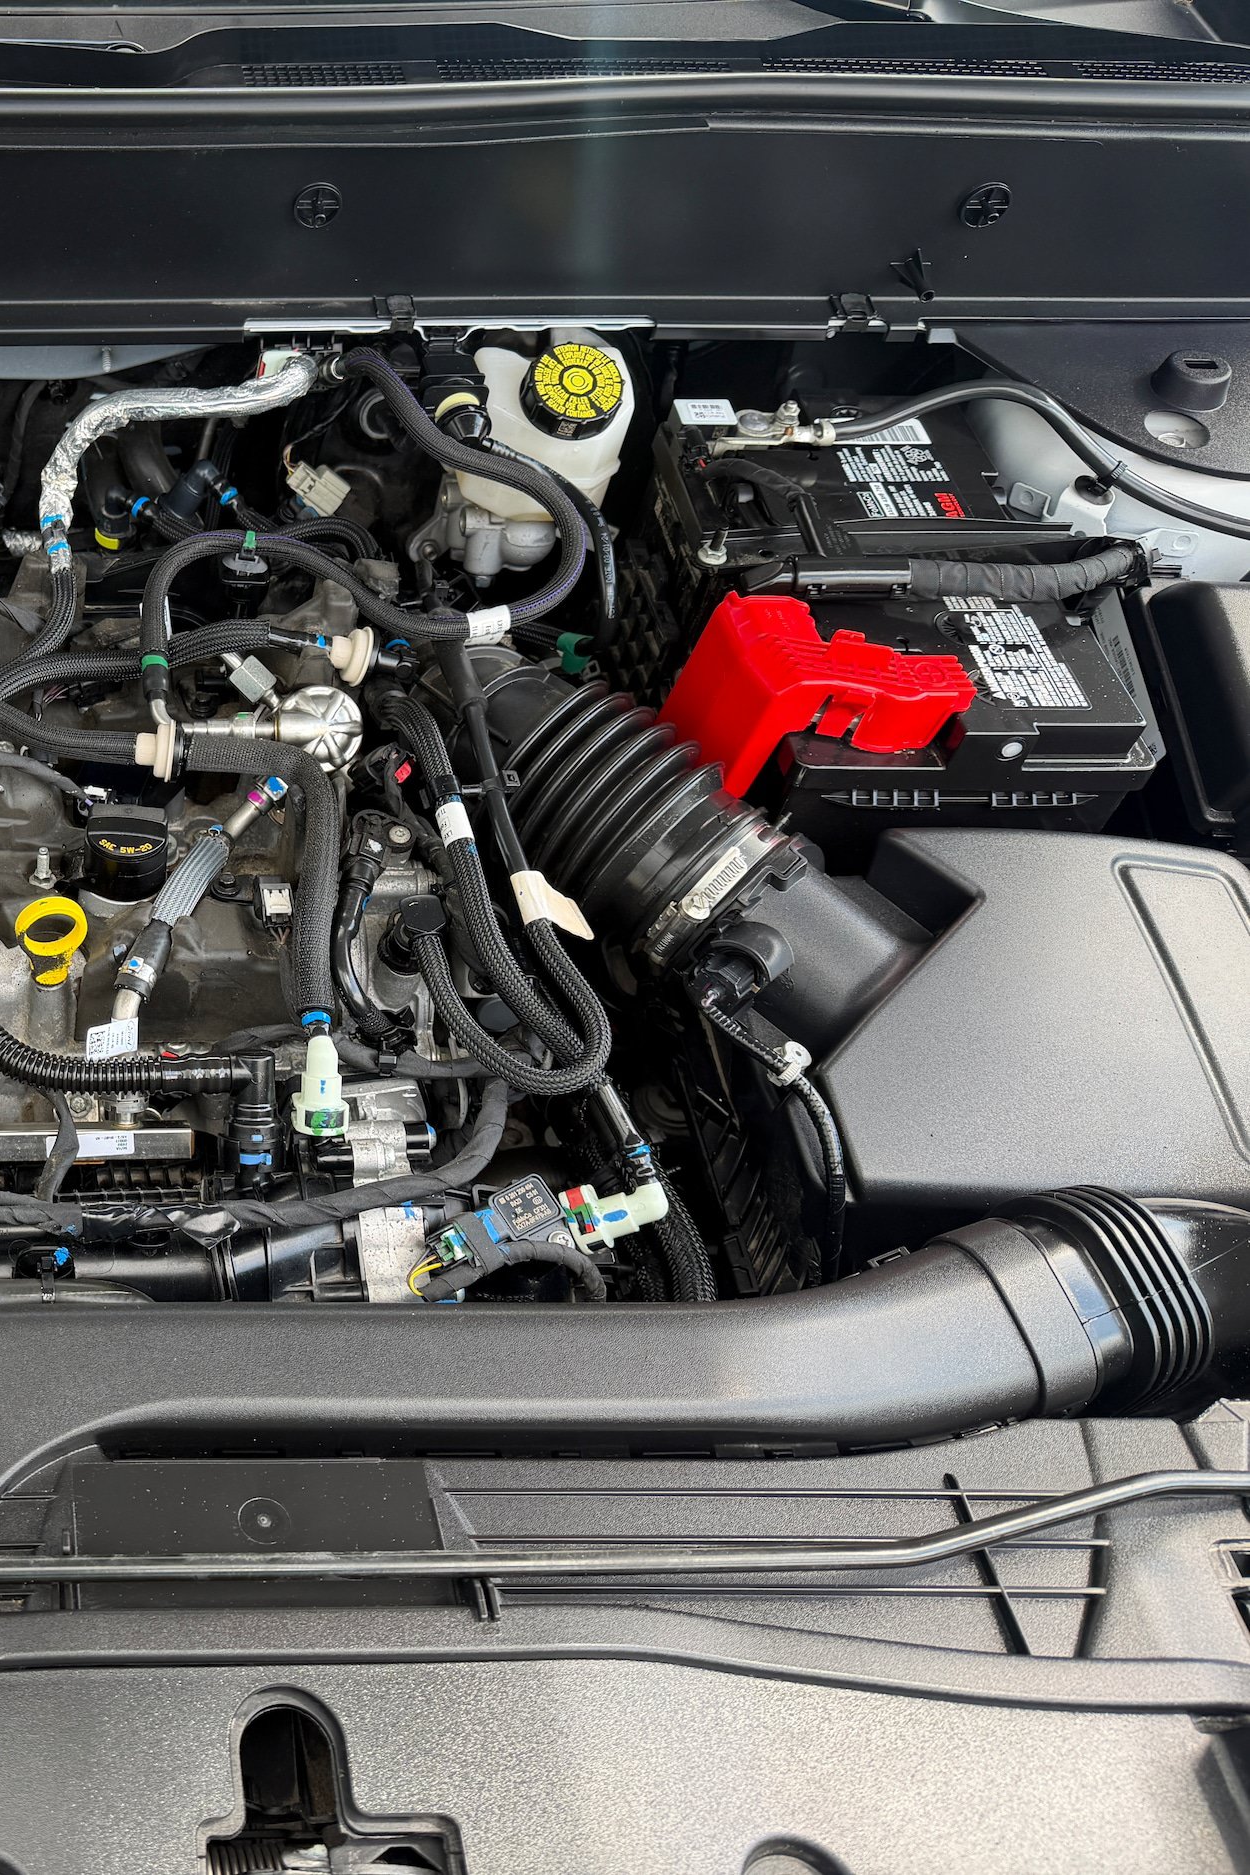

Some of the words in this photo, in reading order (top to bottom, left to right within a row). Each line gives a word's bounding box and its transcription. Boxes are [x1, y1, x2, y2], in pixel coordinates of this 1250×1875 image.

[934, 493, 959, 518] AGM
[99, 839, 117, 851] SAE
[120, 843, 153, 854] 5W-20
